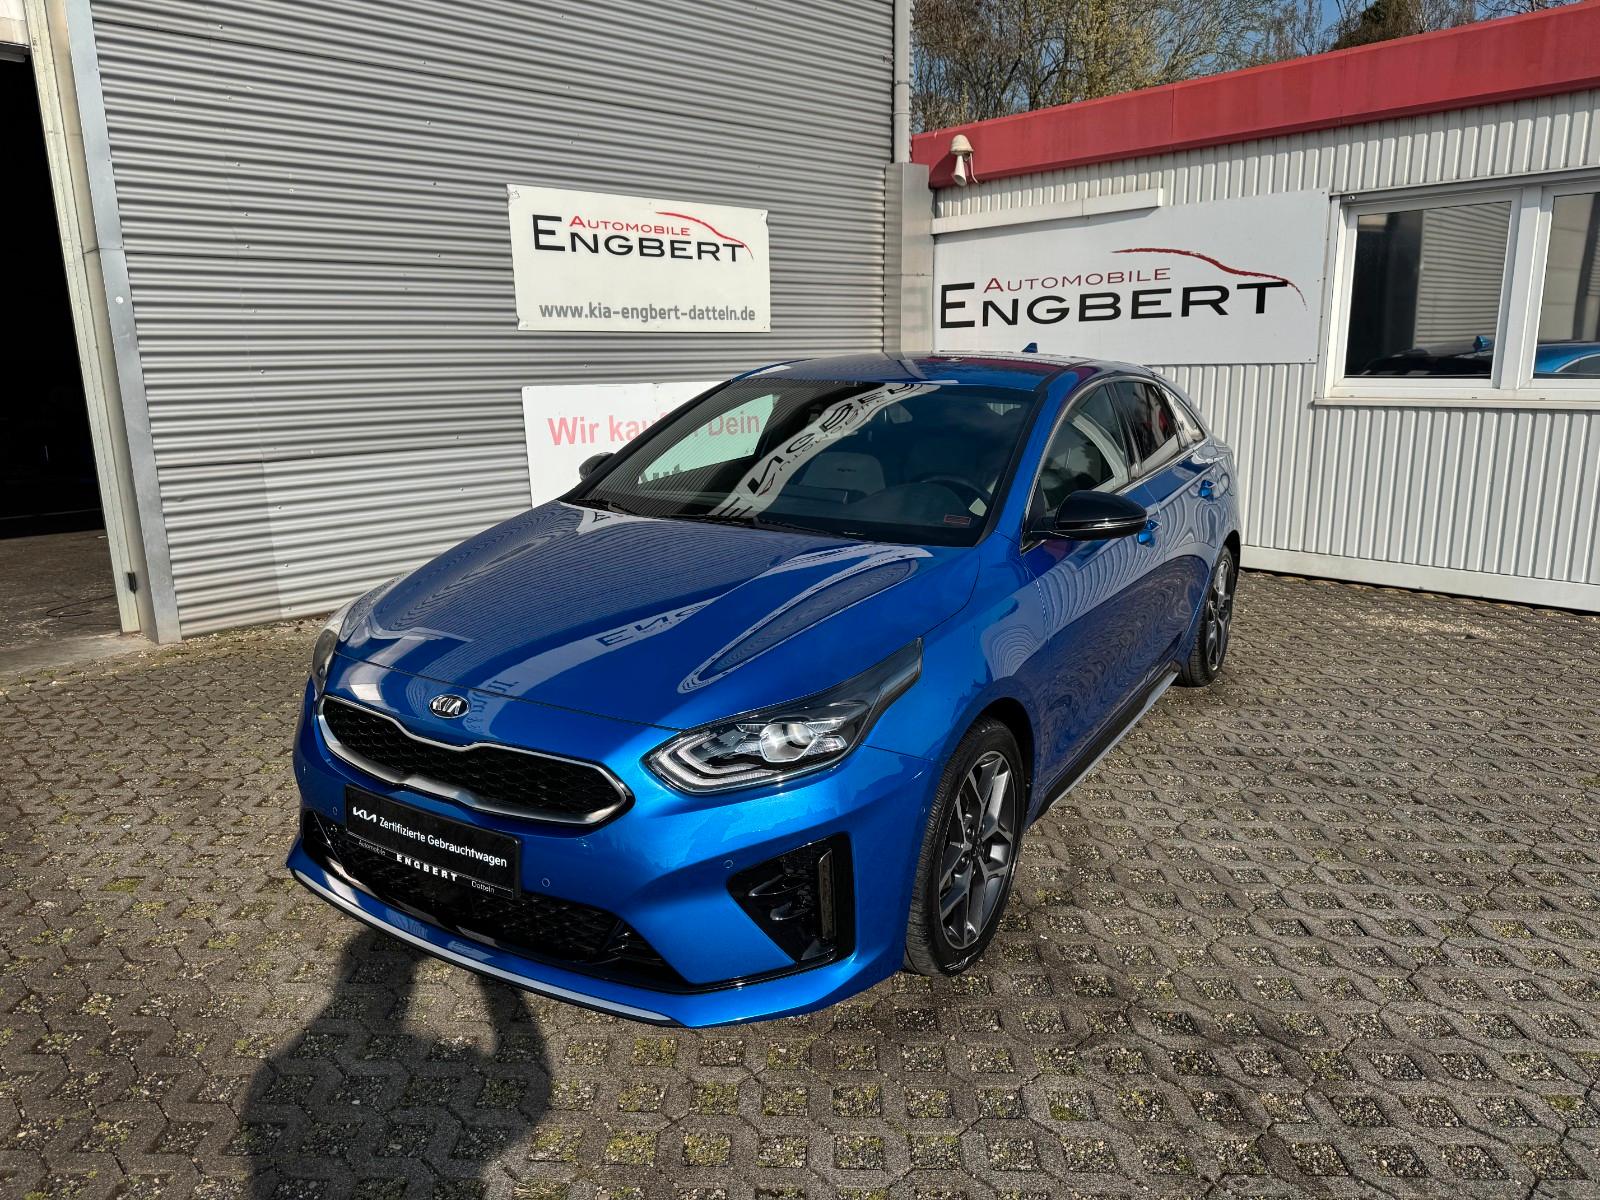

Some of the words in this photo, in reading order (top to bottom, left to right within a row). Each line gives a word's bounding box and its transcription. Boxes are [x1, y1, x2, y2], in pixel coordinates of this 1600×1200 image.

[532, 214, 745, 262] ENGBERT
[539, 301, 756, 323] www.kia-engbert-datteln.de
[940, 279, 1289, 329] ENGBERT
[548, 415, 599, 446] Wir
[379, 816, 426, 843] Zertifizierte
[427, 834, 508, 868] Gebrauchtwagen
[396, 852, 459, 882] ENGBERT
